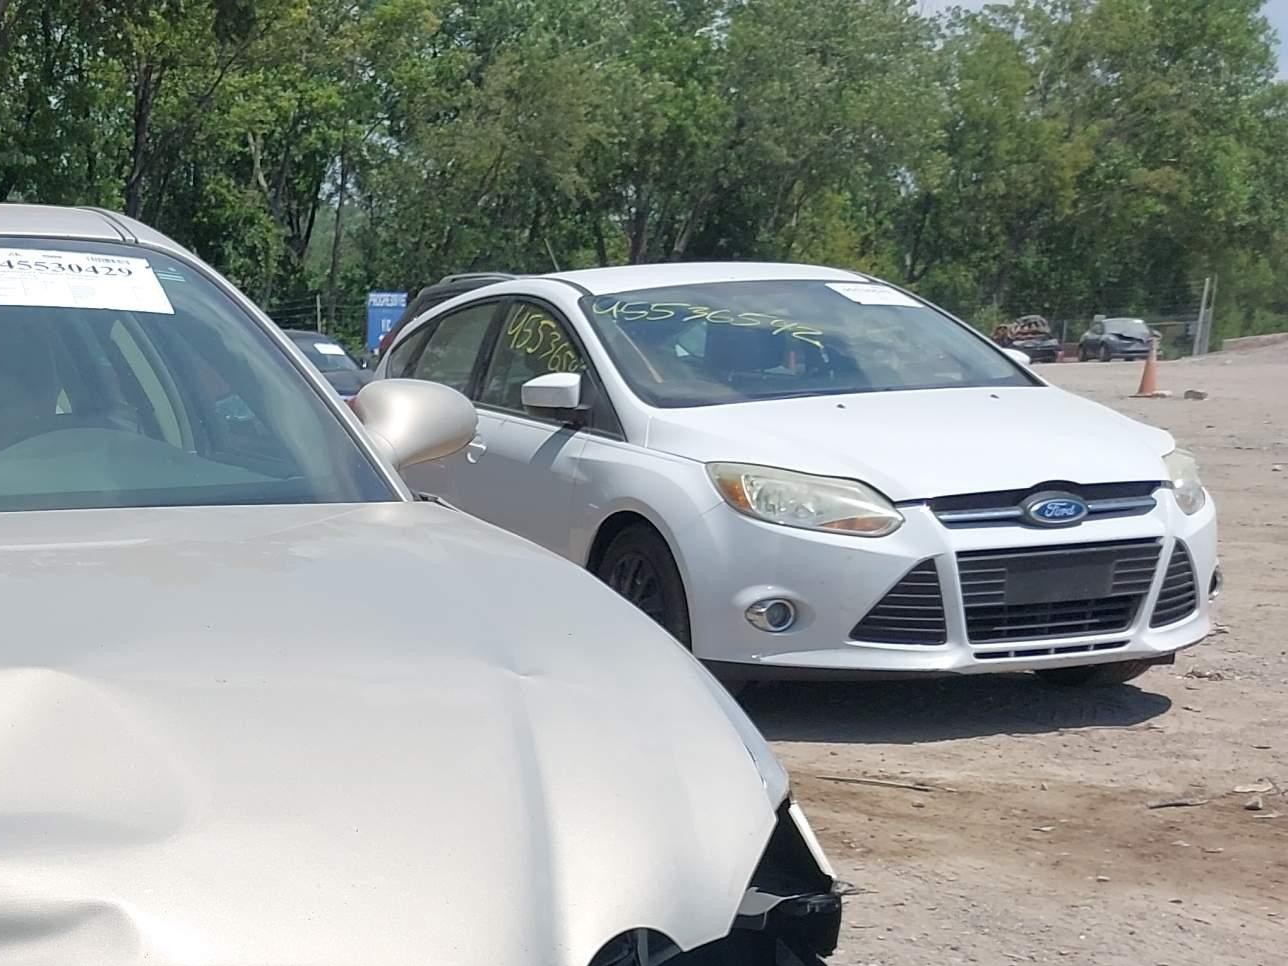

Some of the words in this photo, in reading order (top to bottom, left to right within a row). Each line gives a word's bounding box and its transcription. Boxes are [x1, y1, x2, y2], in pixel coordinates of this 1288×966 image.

[0, 259, 133, 277] 45530429
[592, 300, 825, 349] 45536542
[1044, 502, 1076, 517] Ford
